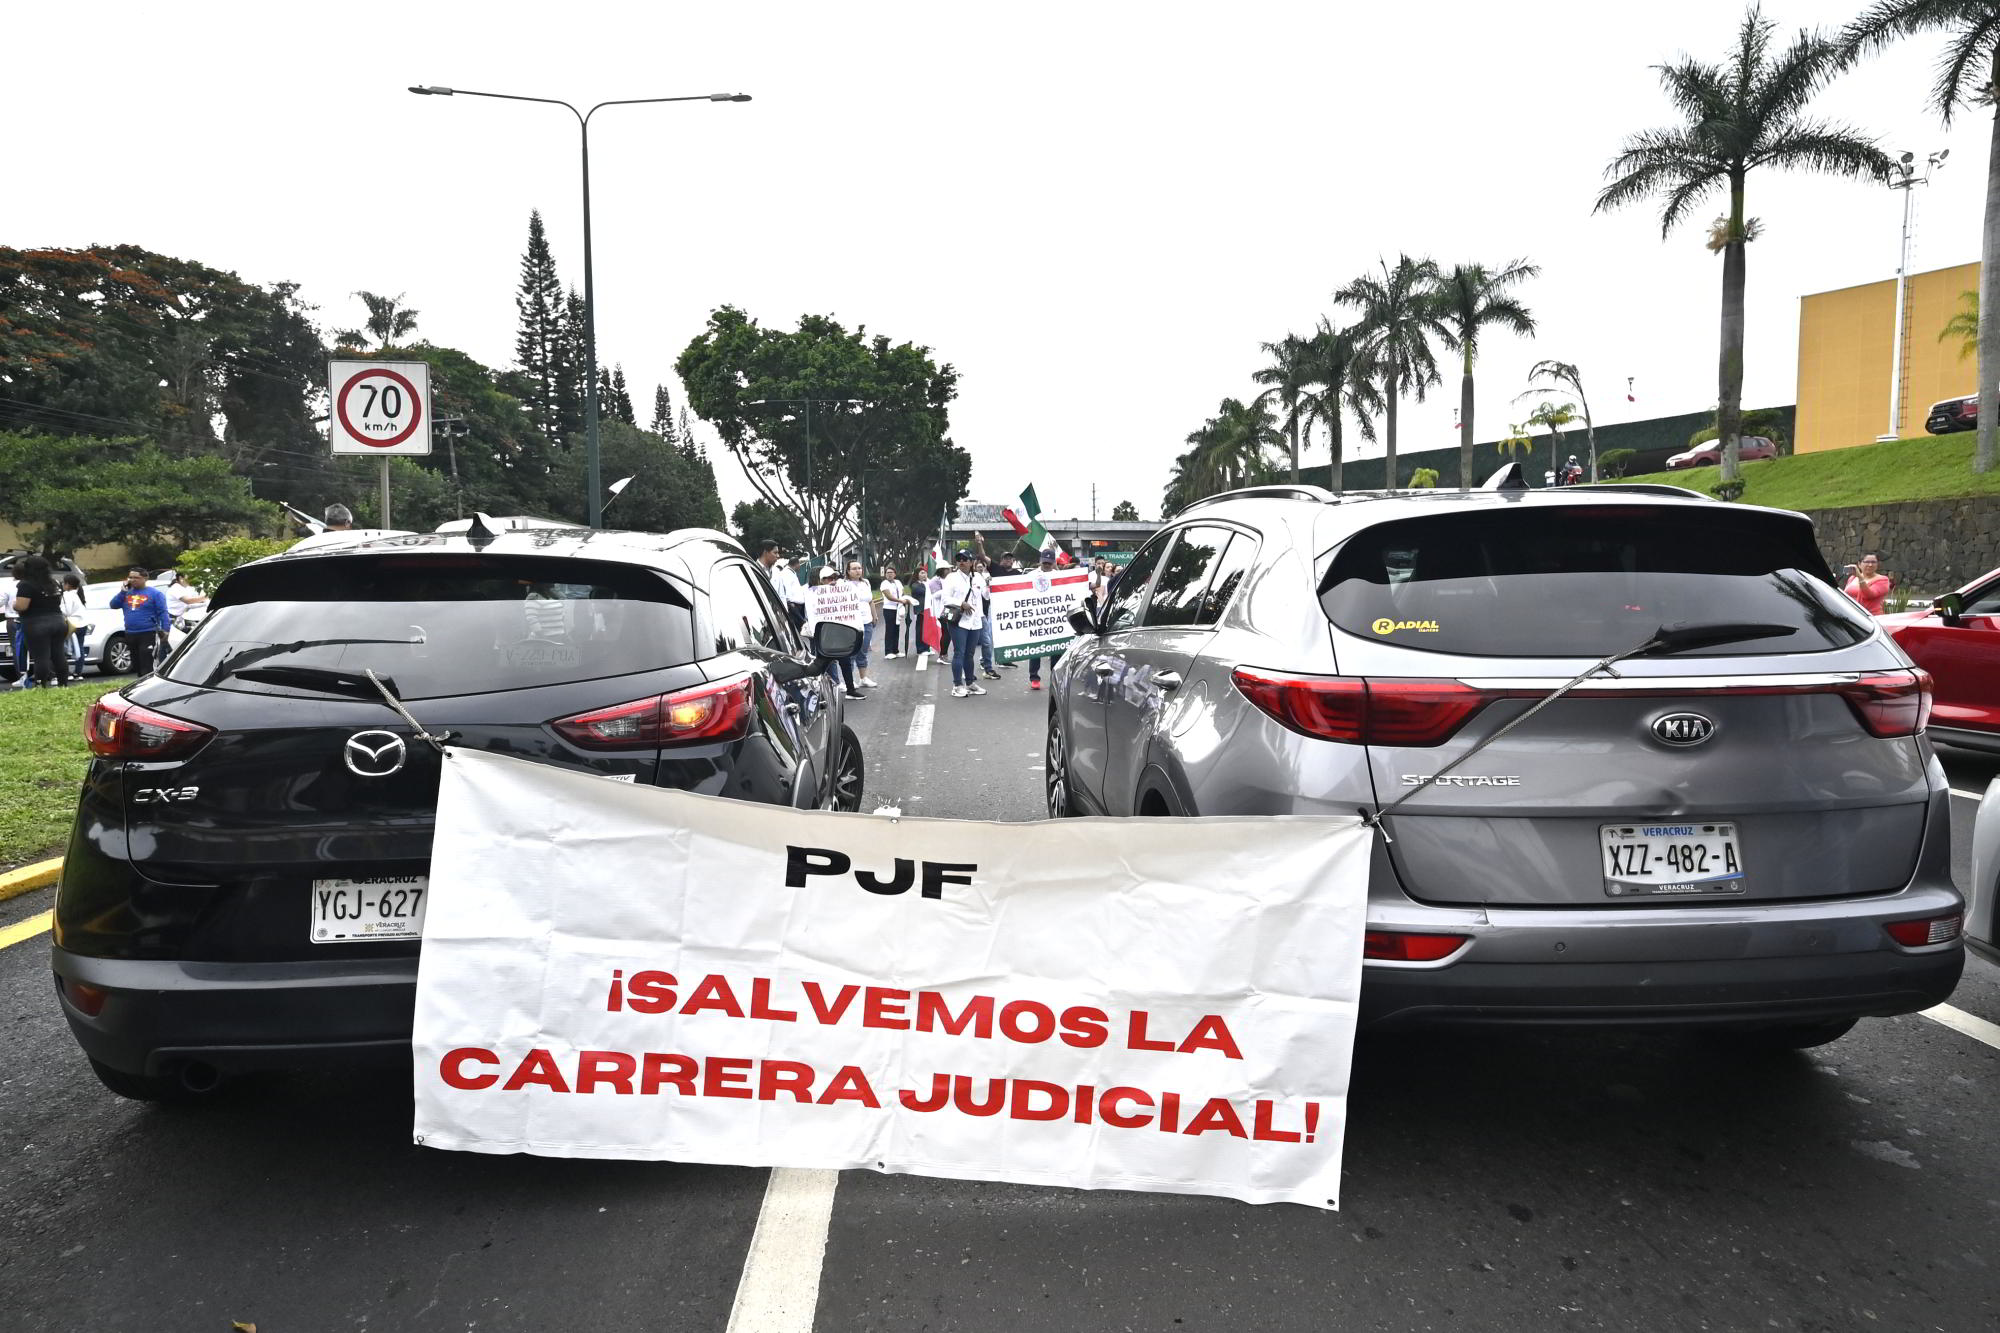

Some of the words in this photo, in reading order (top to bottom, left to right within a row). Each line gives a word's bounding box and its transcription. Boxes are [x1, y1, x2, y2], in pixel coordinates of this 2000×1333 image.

[360, 385, 401, 418] 70
[365, 422, 397, 431] km/h
[1014, 595, 1062, 609] DEFENDER
[1065, 593, 1076, 602] AL
[996, 611, 1020, 621] #PJF
[1022, 608, 1034, 618] ES
[1000, 622, 1013, 631] LA
[1015, 614, 1069, 630] DEMOCRAC
[1029, 625, 1064, 638] MÉXICO
[1373, 619, 1439, 633] RADIAL
[1665, 719, 1705, 738] KIA
[1401, 774, 1521, 787] SPORTAGE
[133, 786, 200, 804] CX-3
[1642, 826, 1695, 837] VERACRUZ
[1609, 842, 1739, 876] XZZ-482-A
[356, 874, 418, 885] ERACRUZ
[785, 845, 978, 900] PJF
[1659, 883, 1695, 891] VERACRUZ
[319, 889, 423, 920] YGJ-627
[376, 921, 406, 929] VERACRUZ
[607, 969, 1109, 1049] ¡SALVEMOS
[1127, 1010, 1244, 1060] LA
[439, 1047, 881, 1109] CARRERA
[898, 1073, 1320, 1144] JUDICIAL!
